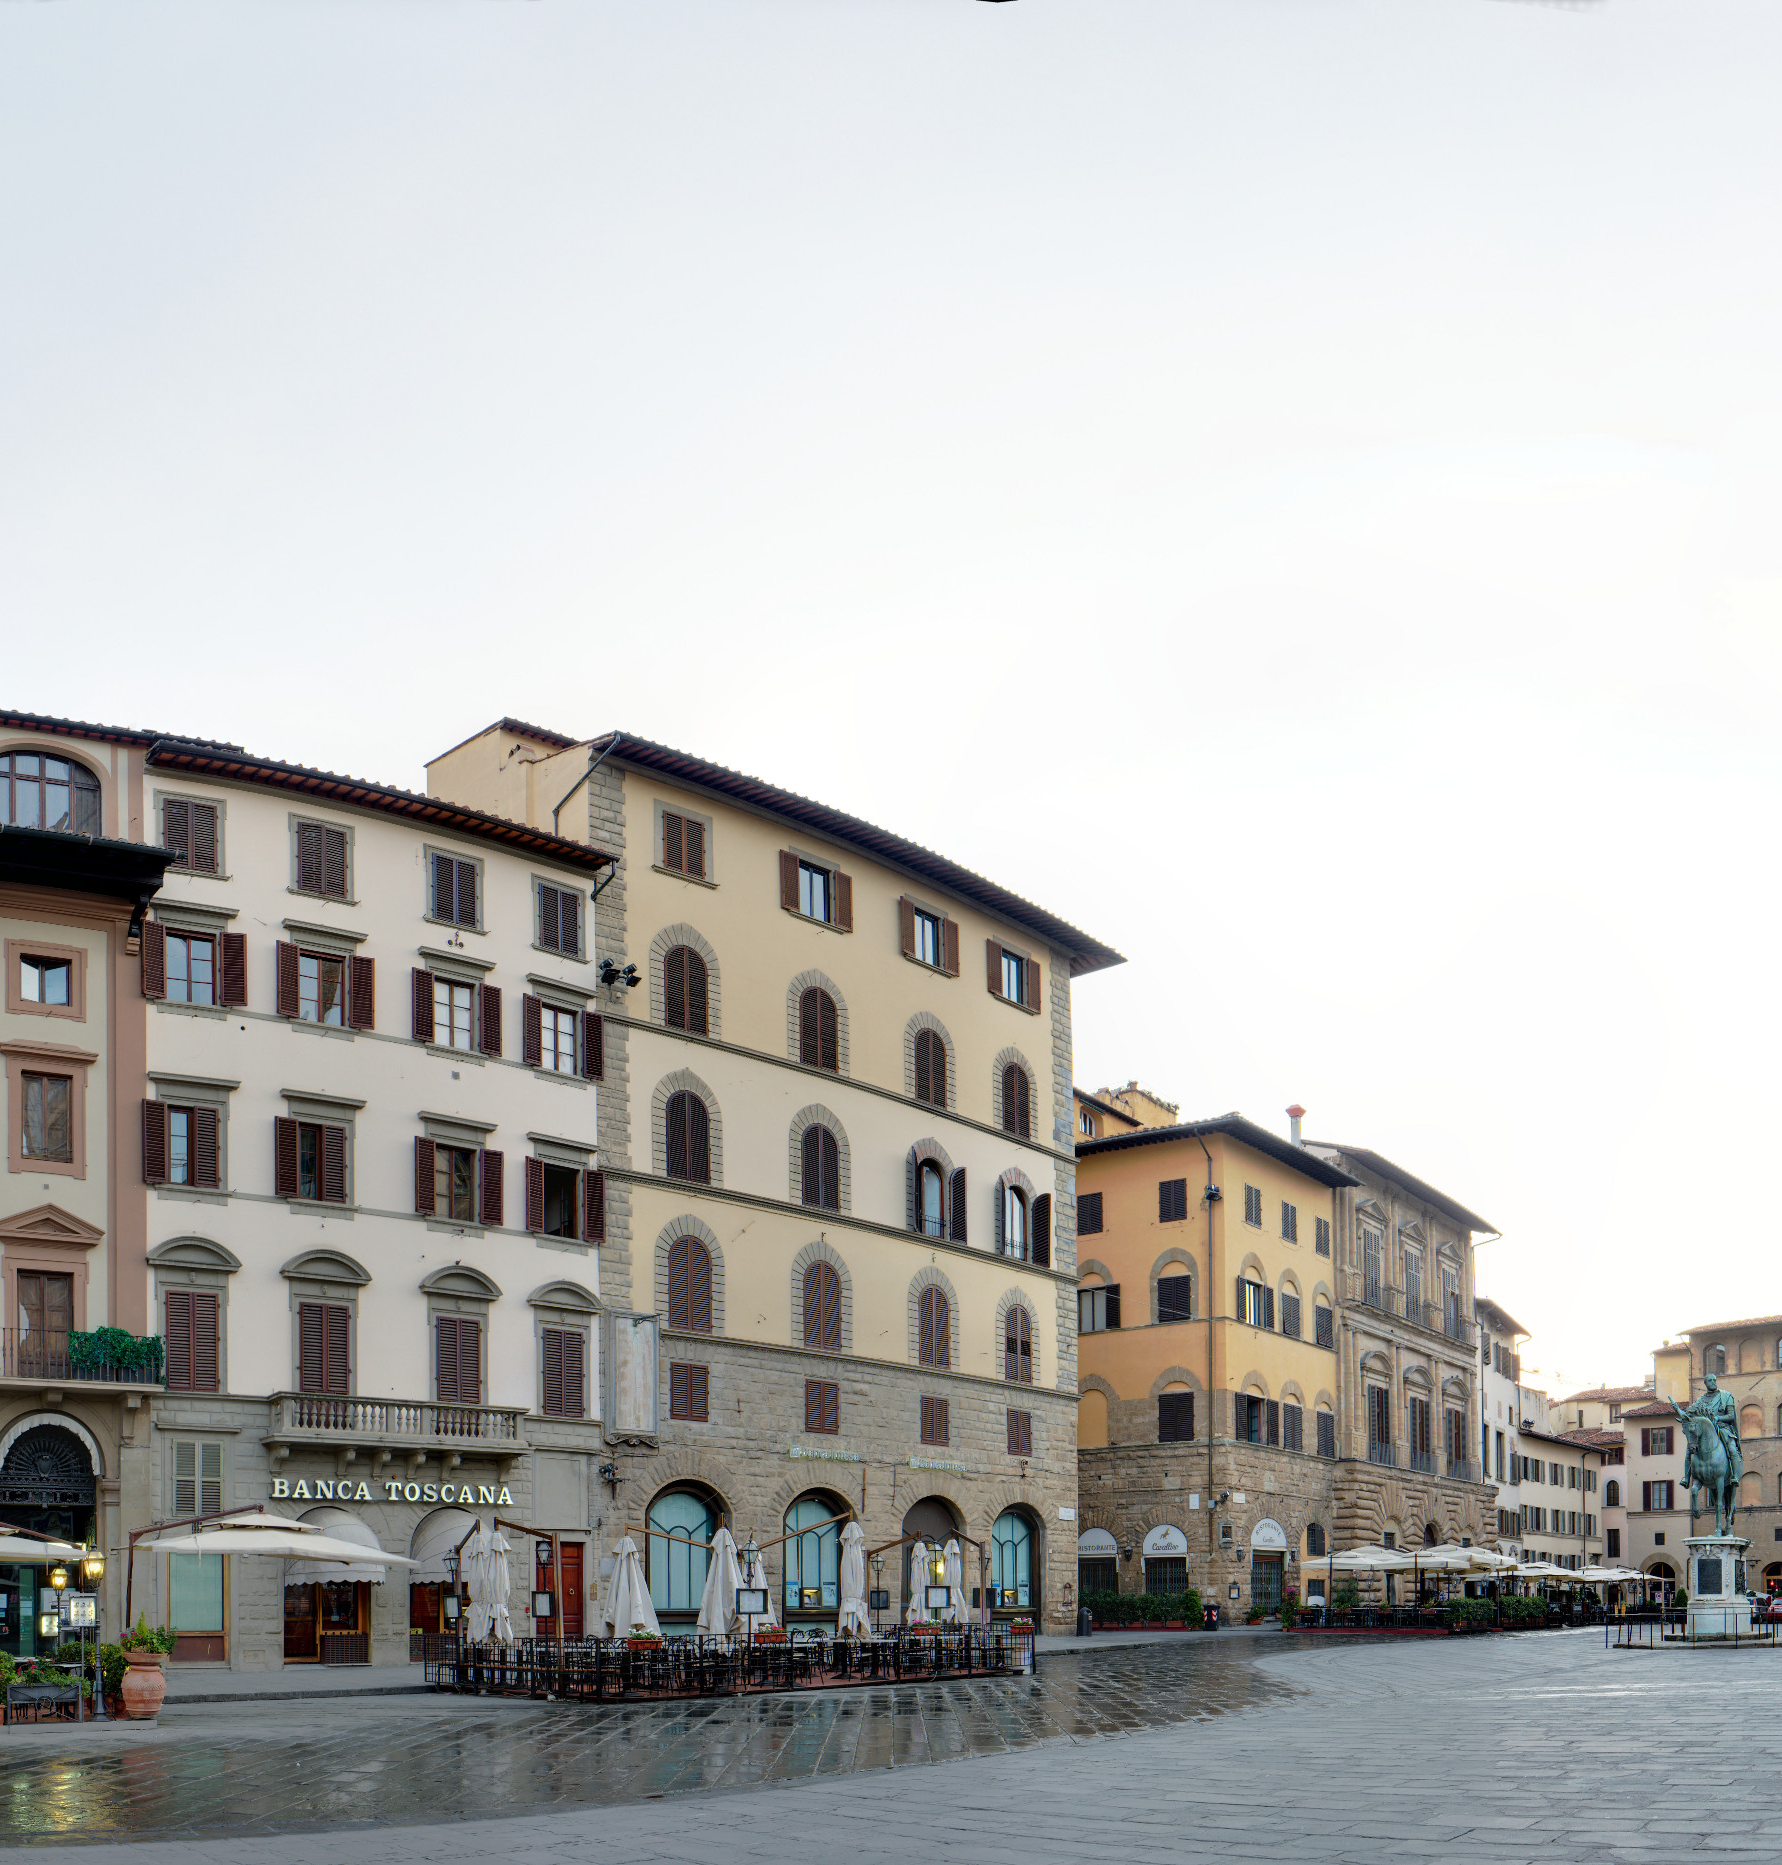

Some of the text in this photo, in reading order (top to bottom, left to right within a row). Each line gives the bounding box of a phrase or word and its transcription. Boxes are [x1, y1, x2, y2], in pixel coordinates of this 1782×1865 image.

[272, 1478, 514, 1505] BANCA TOSCANA
[1256, 1523, 1281, 1536] RISTORANTE
